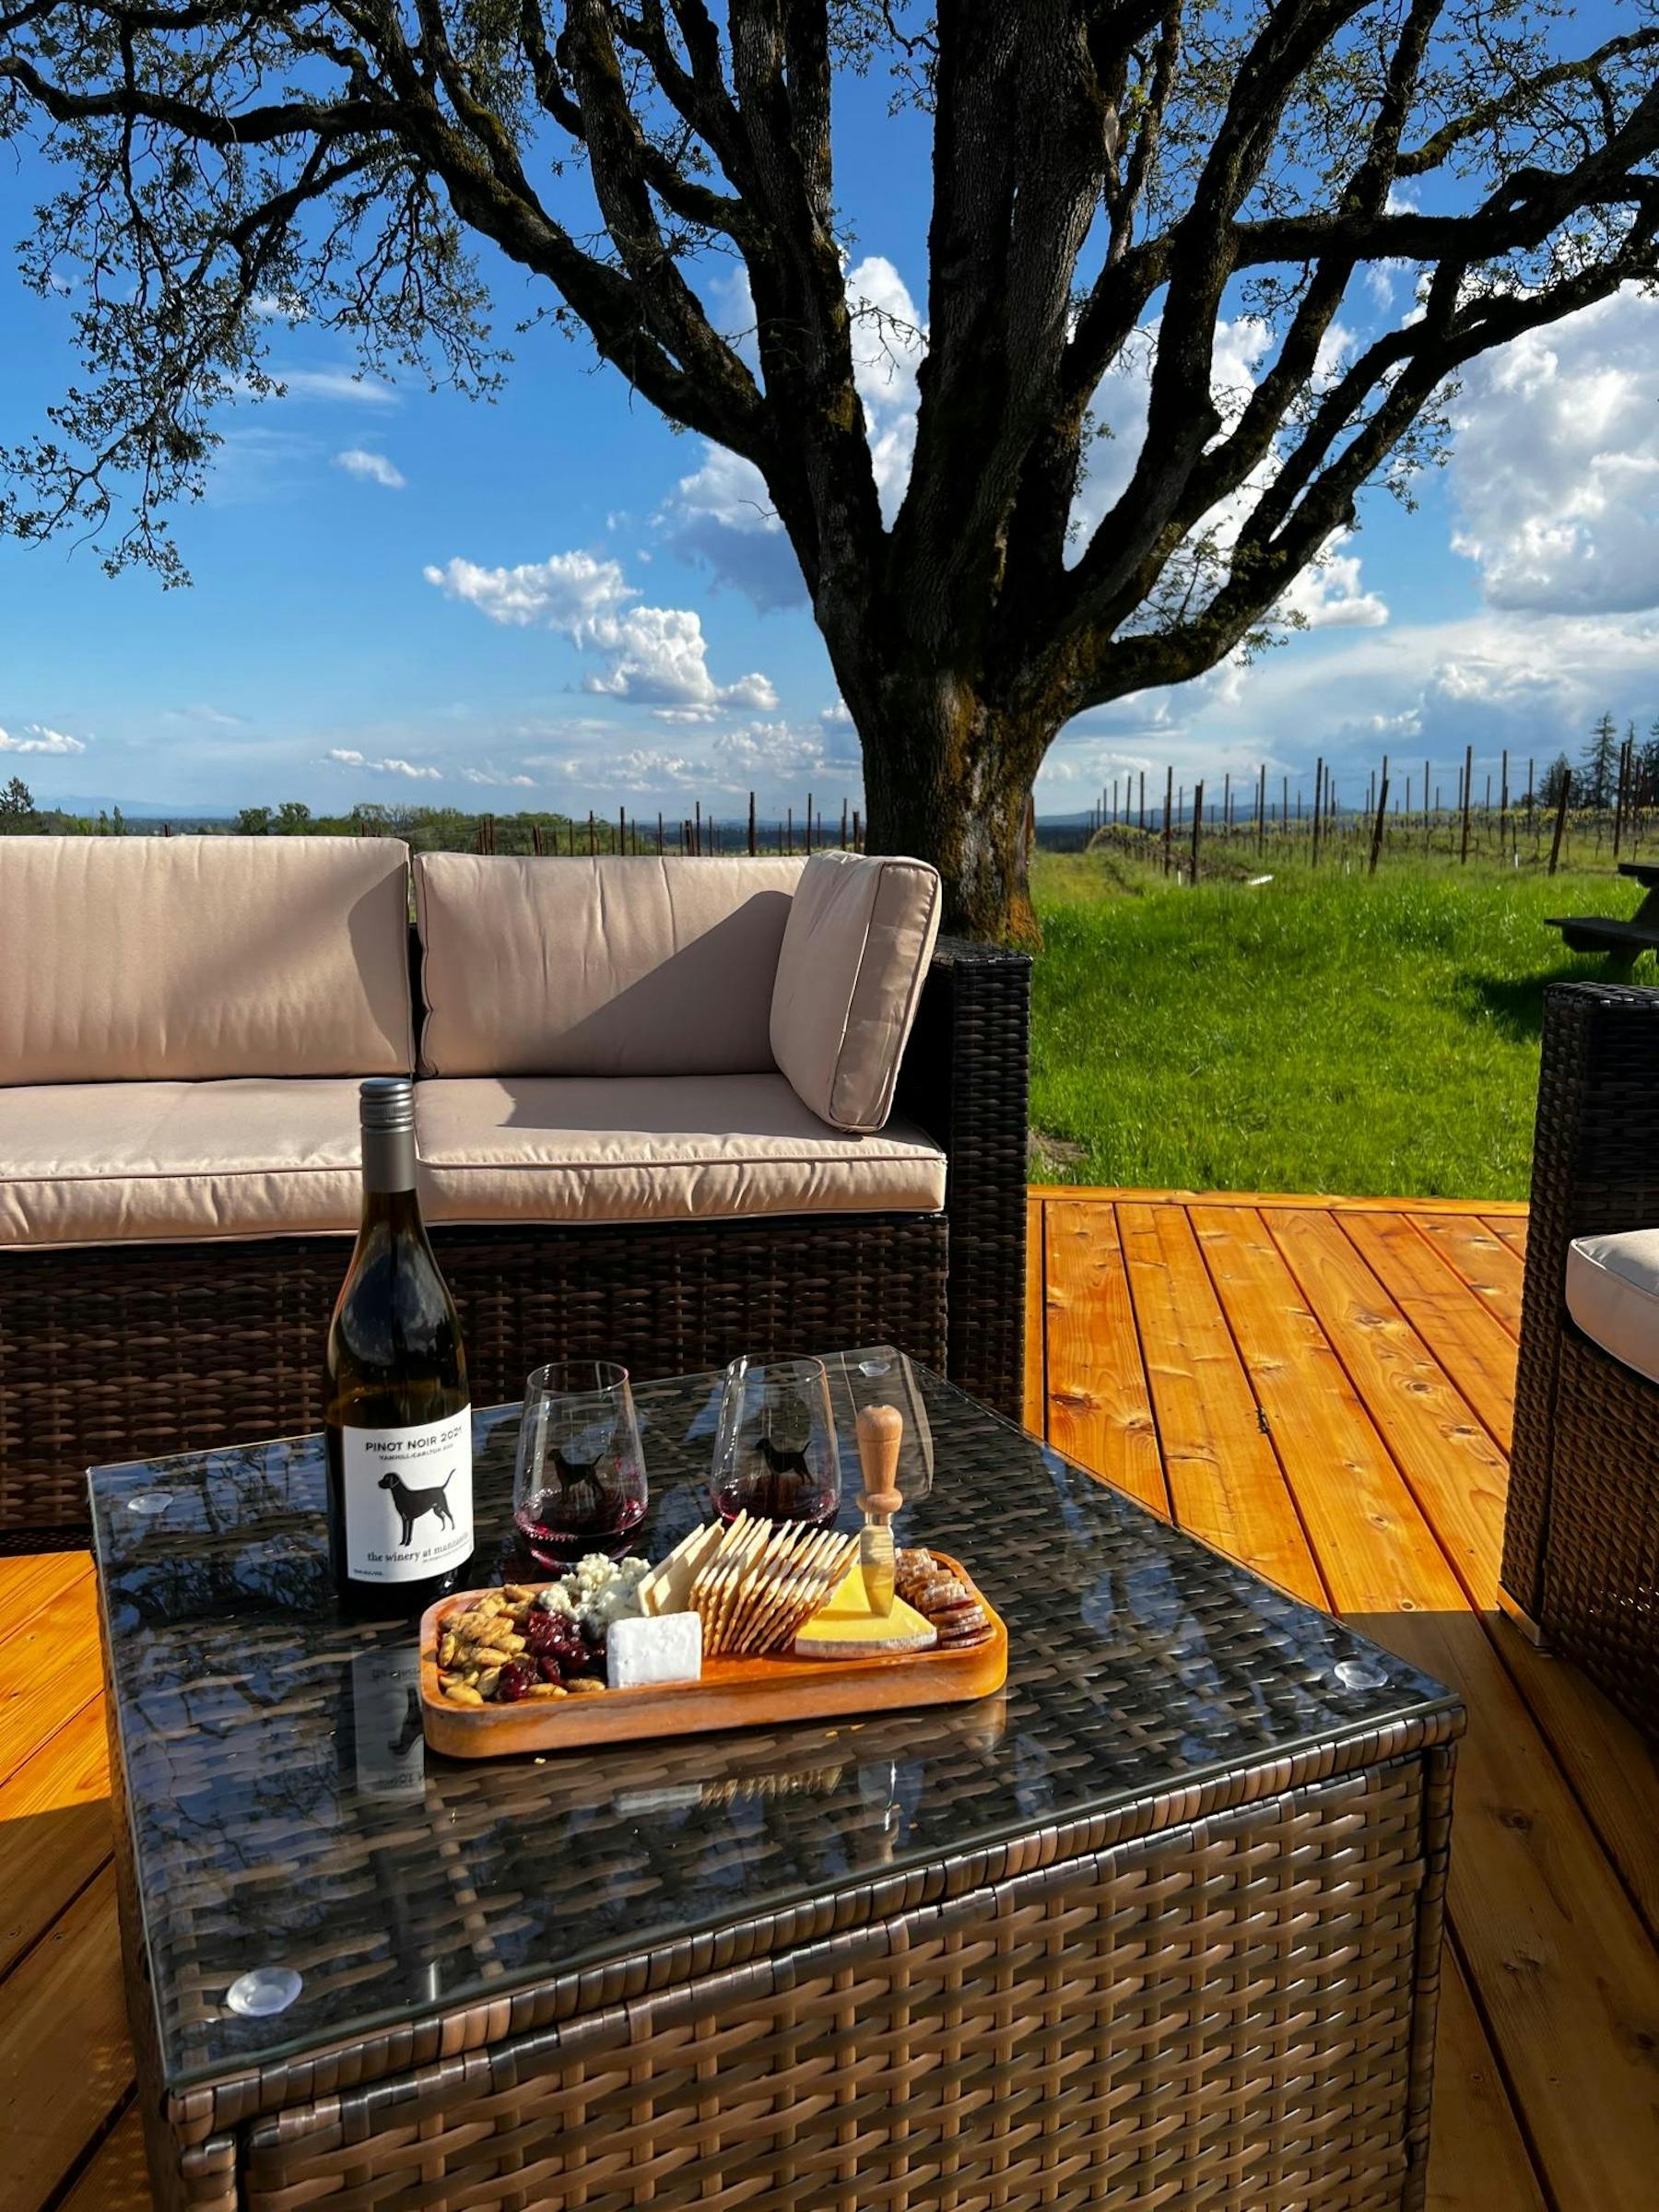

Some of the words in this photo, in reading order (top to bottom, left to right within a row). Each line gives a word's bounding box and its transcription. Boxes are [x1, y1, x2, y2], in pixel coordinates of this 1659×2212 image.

[365, 1441, 403, 1452] PINOT
[407, 1435, 437, 1450] NOIR
[367, 1551, 383, 1562] the
[385, 1550, 420, 1563] winery
[423, 1548, 431, 1558] at
